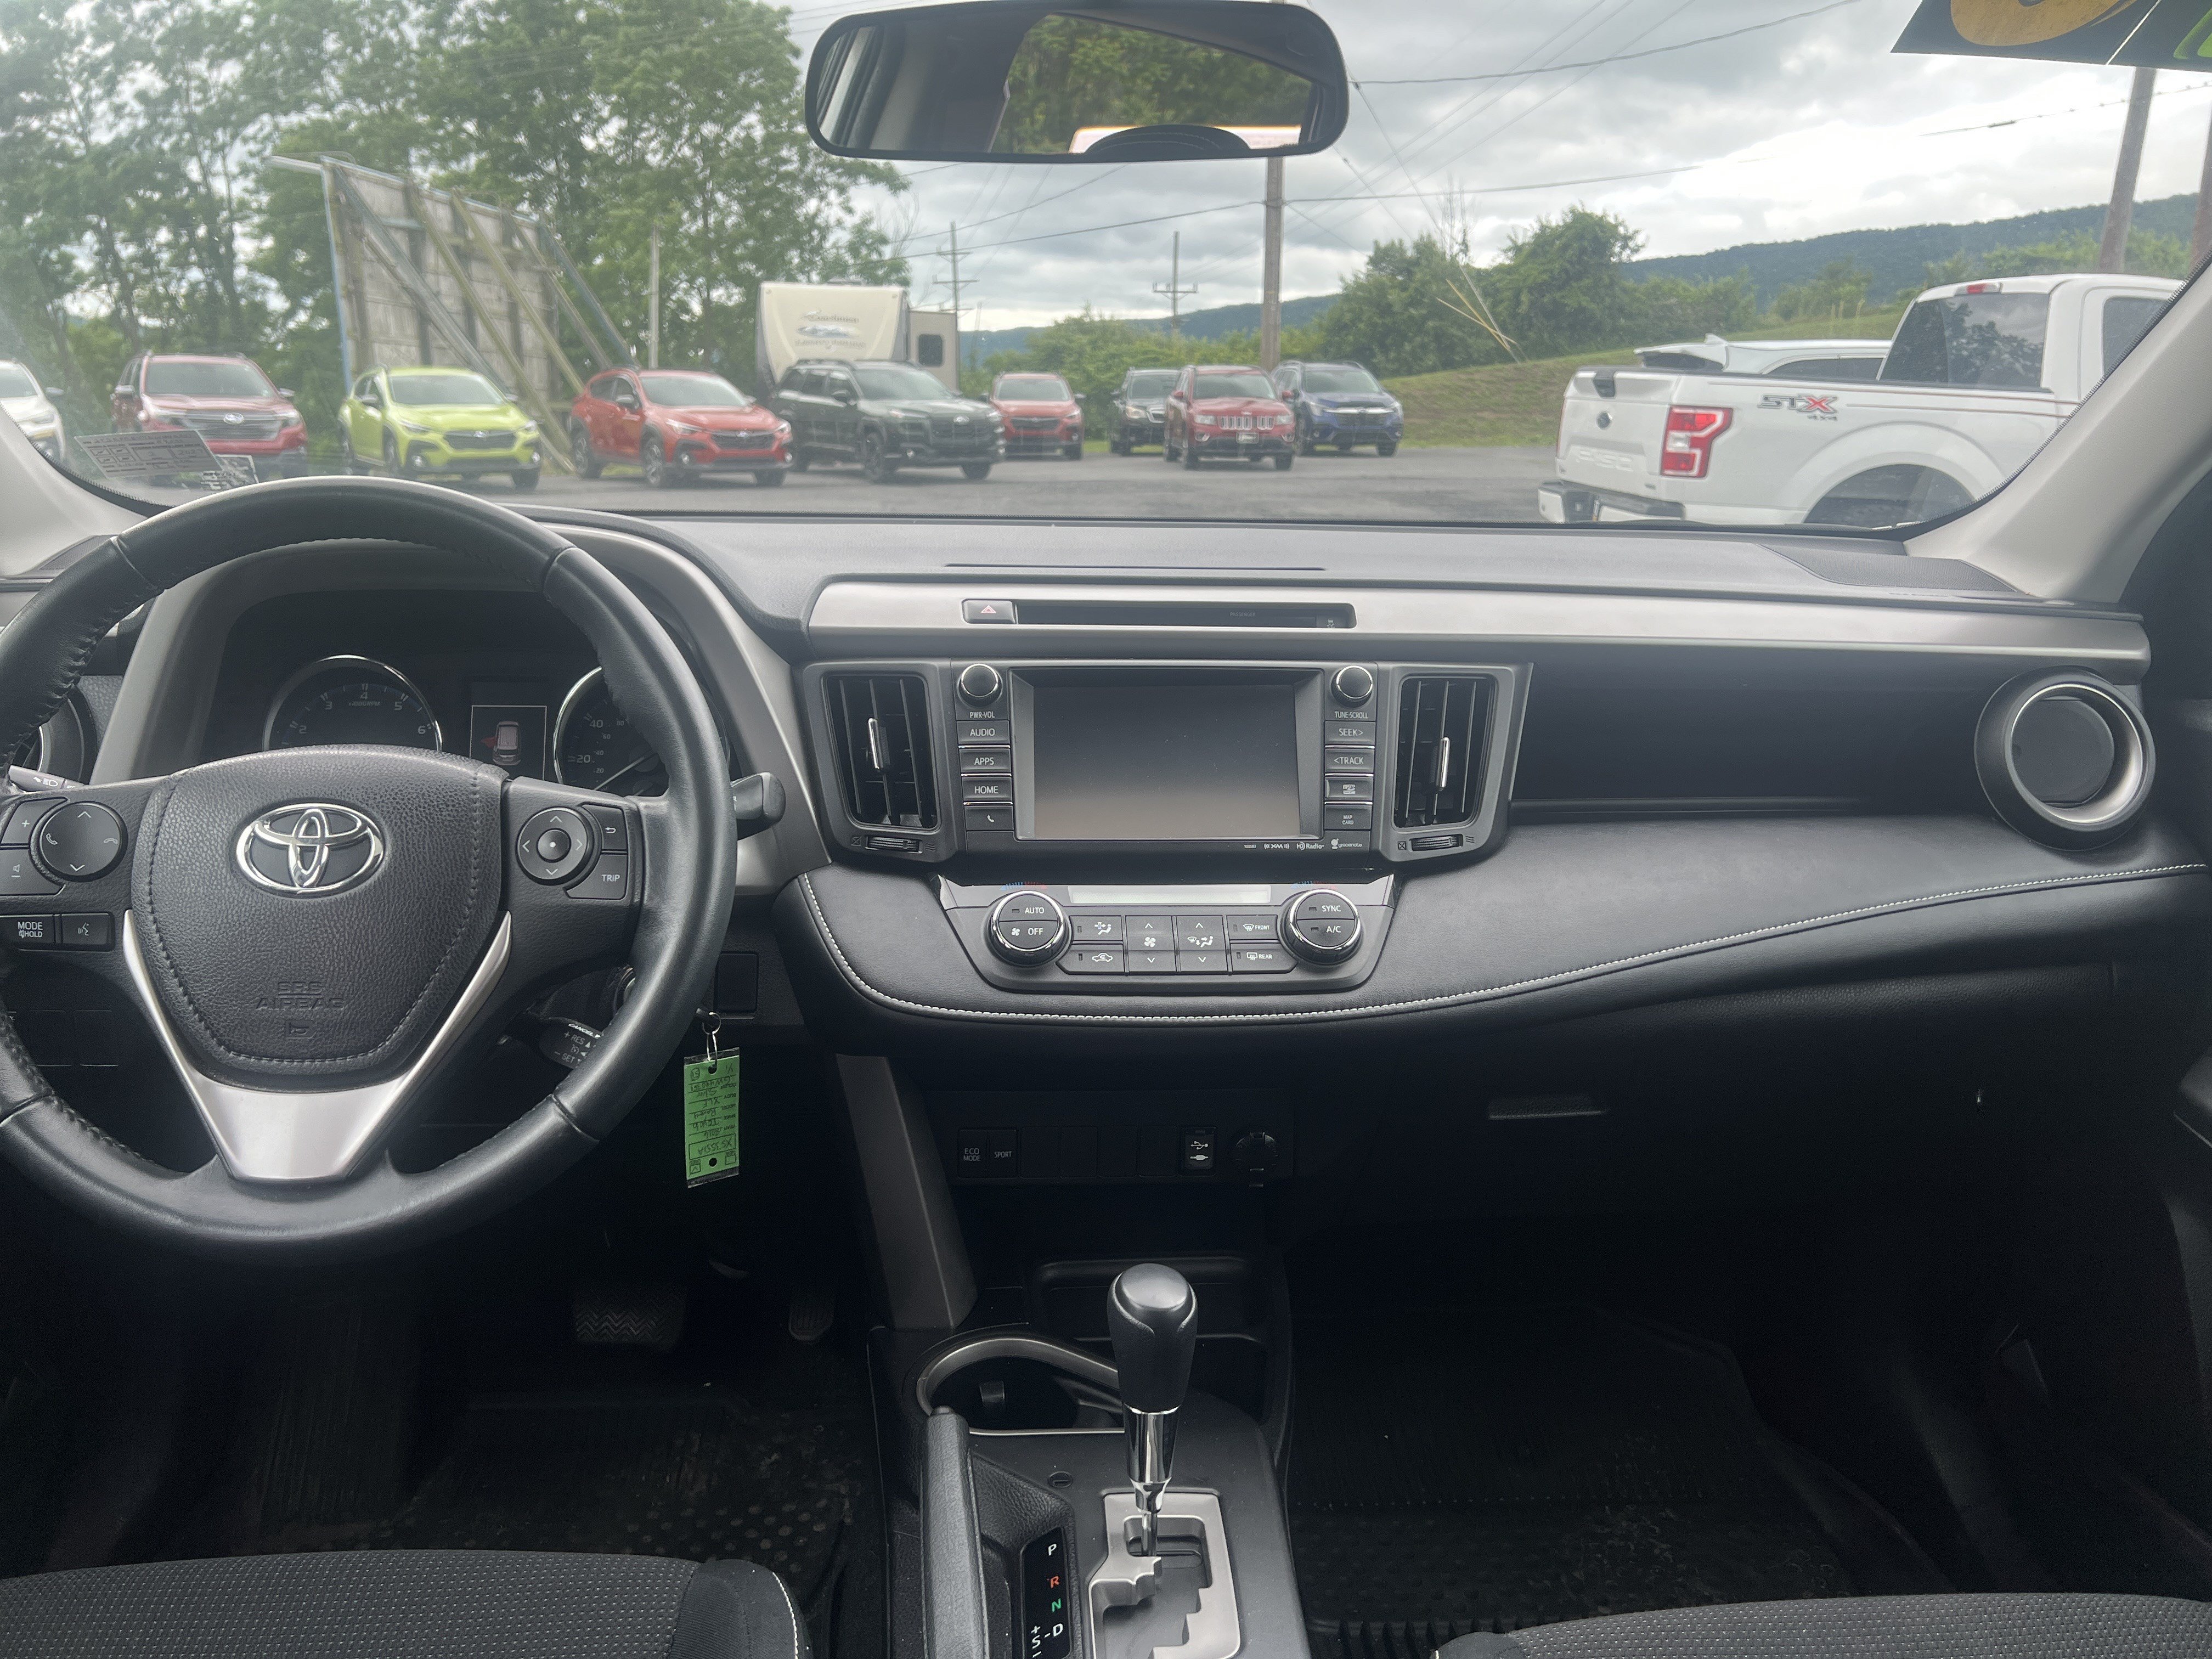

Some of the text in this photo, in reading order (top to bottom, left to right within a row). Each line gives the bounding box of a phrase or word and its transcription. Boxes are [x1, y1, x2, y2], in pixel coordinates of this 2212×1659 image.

[1757, 394, 1839, 413] STX
[359, 691, 369, 699] 4
[325, 701, 333, 710] 3
[394, 701, 403, 711] 5
[589, 719, 603, 728] 40
[298, 725, 307, 734] 2
[417, 725, 426, 735] 6
[970, 729, 996, 737] AUDIO
[576, 754, 591, 763] 20
[974, 757, 994, 765] APPS
[974, 786, 998, 794] HOME
[602, 874, 620, 883] TRIP
[1024, 906, 1045, 915] AUTO
[18, 921, 43, 930] MODE
[1325, 925, 1341, 934] A/C
[1028, 927, 1043, 936] OFF
[568, 1023, 594, 1037] CANCEL
[571, 1034, 585, 1045] RES
[562, 1053, 575, 1063] SET
[994, 1150, 1012, 1159] SPORT
[1048, 1543, 1057, 1556] P
[1049, 1576, 1060, 1588] R
[1052, 1598, 1062, 1612] N
[1053, 1623, 1063, 1637] D
[1032, 1635, 1041, 1649] S
